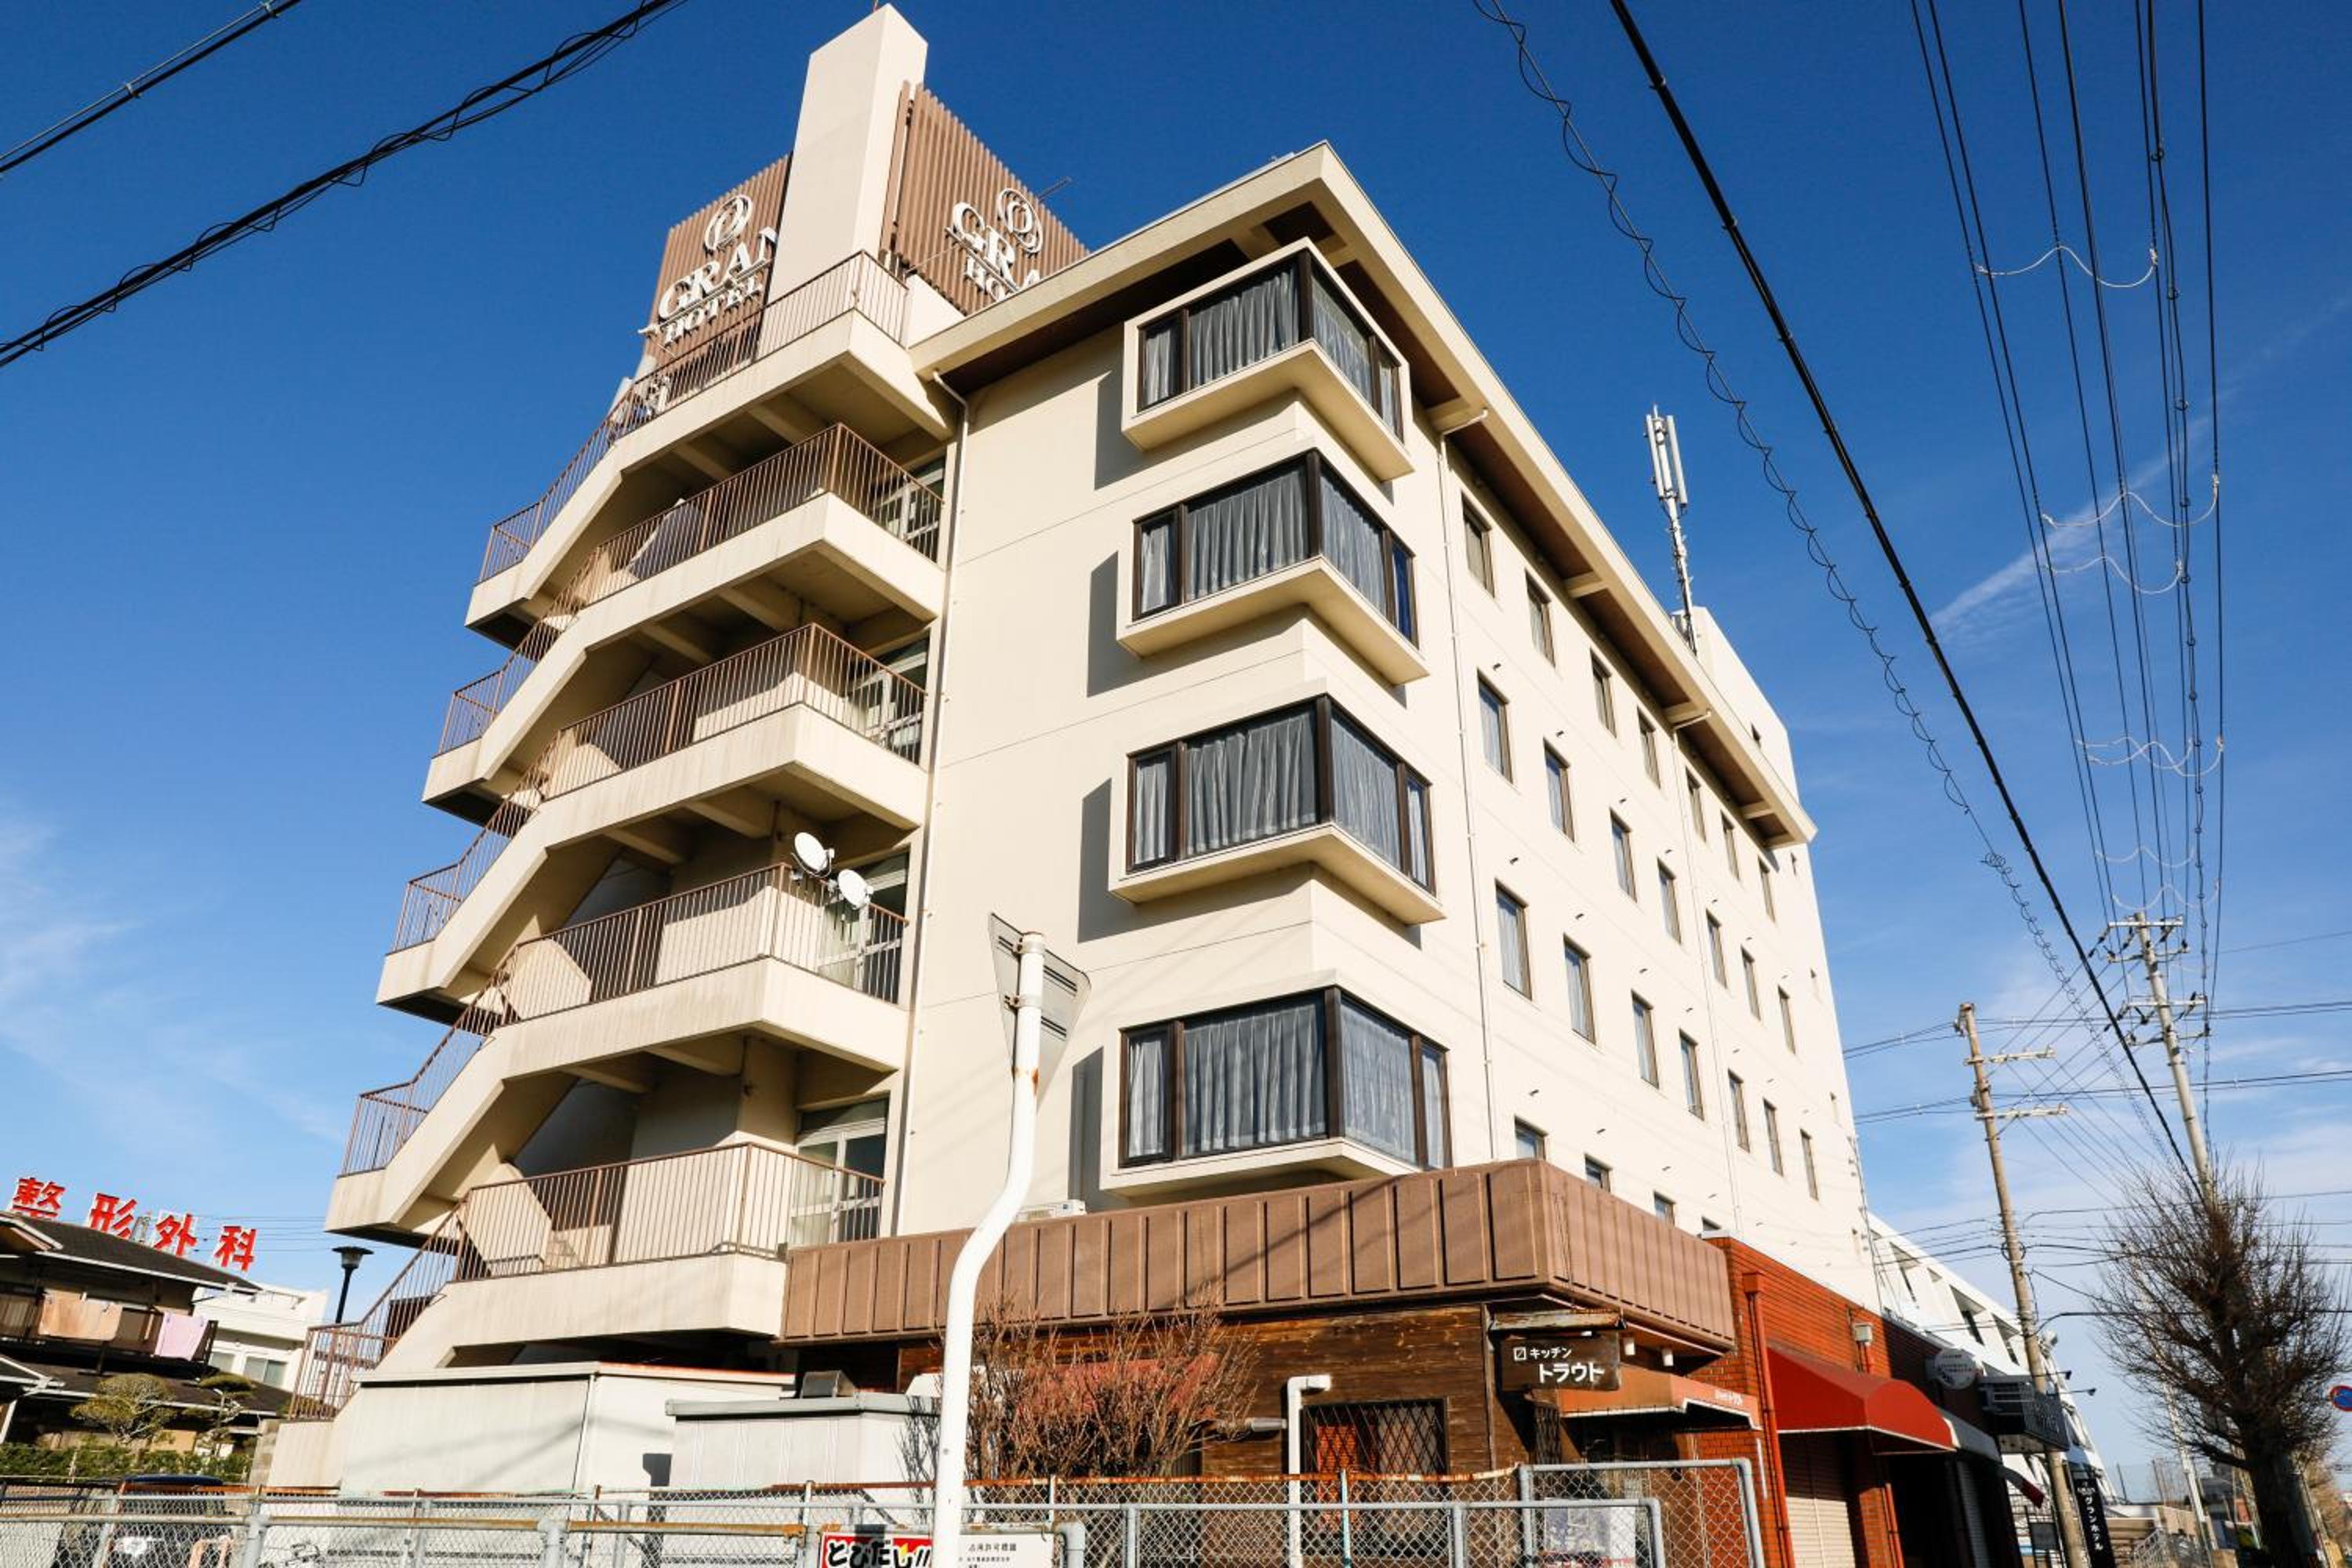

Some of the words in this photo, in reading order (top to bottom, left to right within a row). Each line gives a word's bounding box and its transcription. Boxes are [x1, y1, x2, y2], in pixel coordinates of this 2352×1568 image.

[10, 1176, 259, 1272] 整形外科
[1530, 1347, 1572, 1359] キッチン
[1538, 1362, 1605, 1384] トラウト
